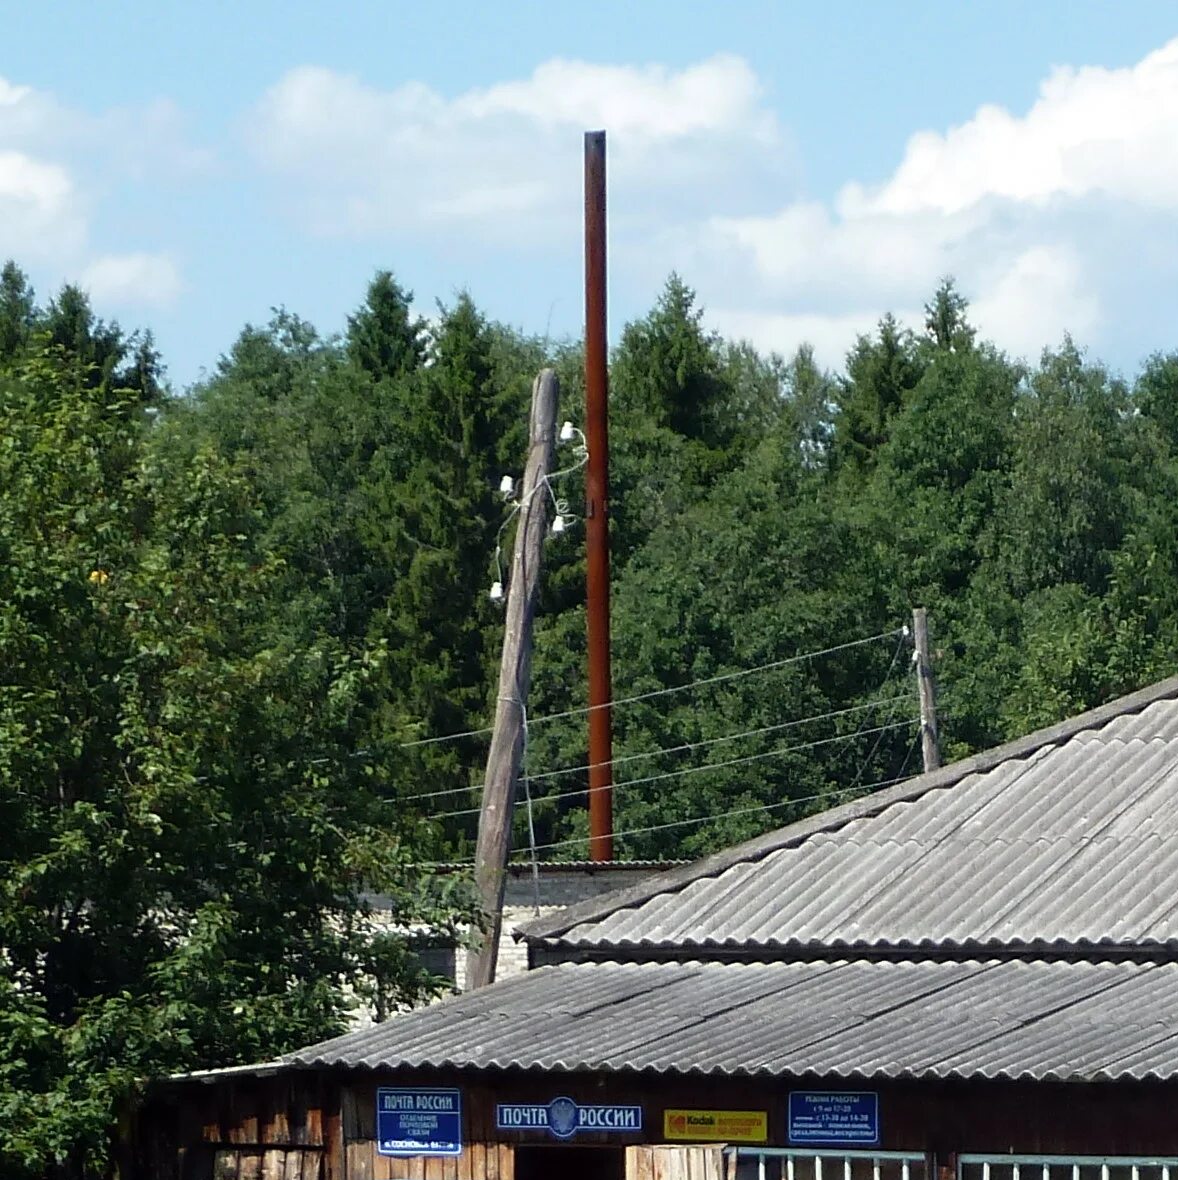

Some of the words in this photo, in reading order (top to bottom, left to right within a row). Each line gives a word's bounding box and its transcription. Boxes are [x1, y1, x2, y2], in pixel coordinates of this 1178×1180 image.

[384, 1095, 414, 1110] ПОЧТА
[416, 1095, 453, 1110] РОССИИ
[831, 1095, 860, 1103] РАБОТЫ
[503, 1108, 548, 1124] ПОЧТА
[579, 1108, 635, 1126] РОССИИ
[687, 1115, 715, 1125] Kodak
